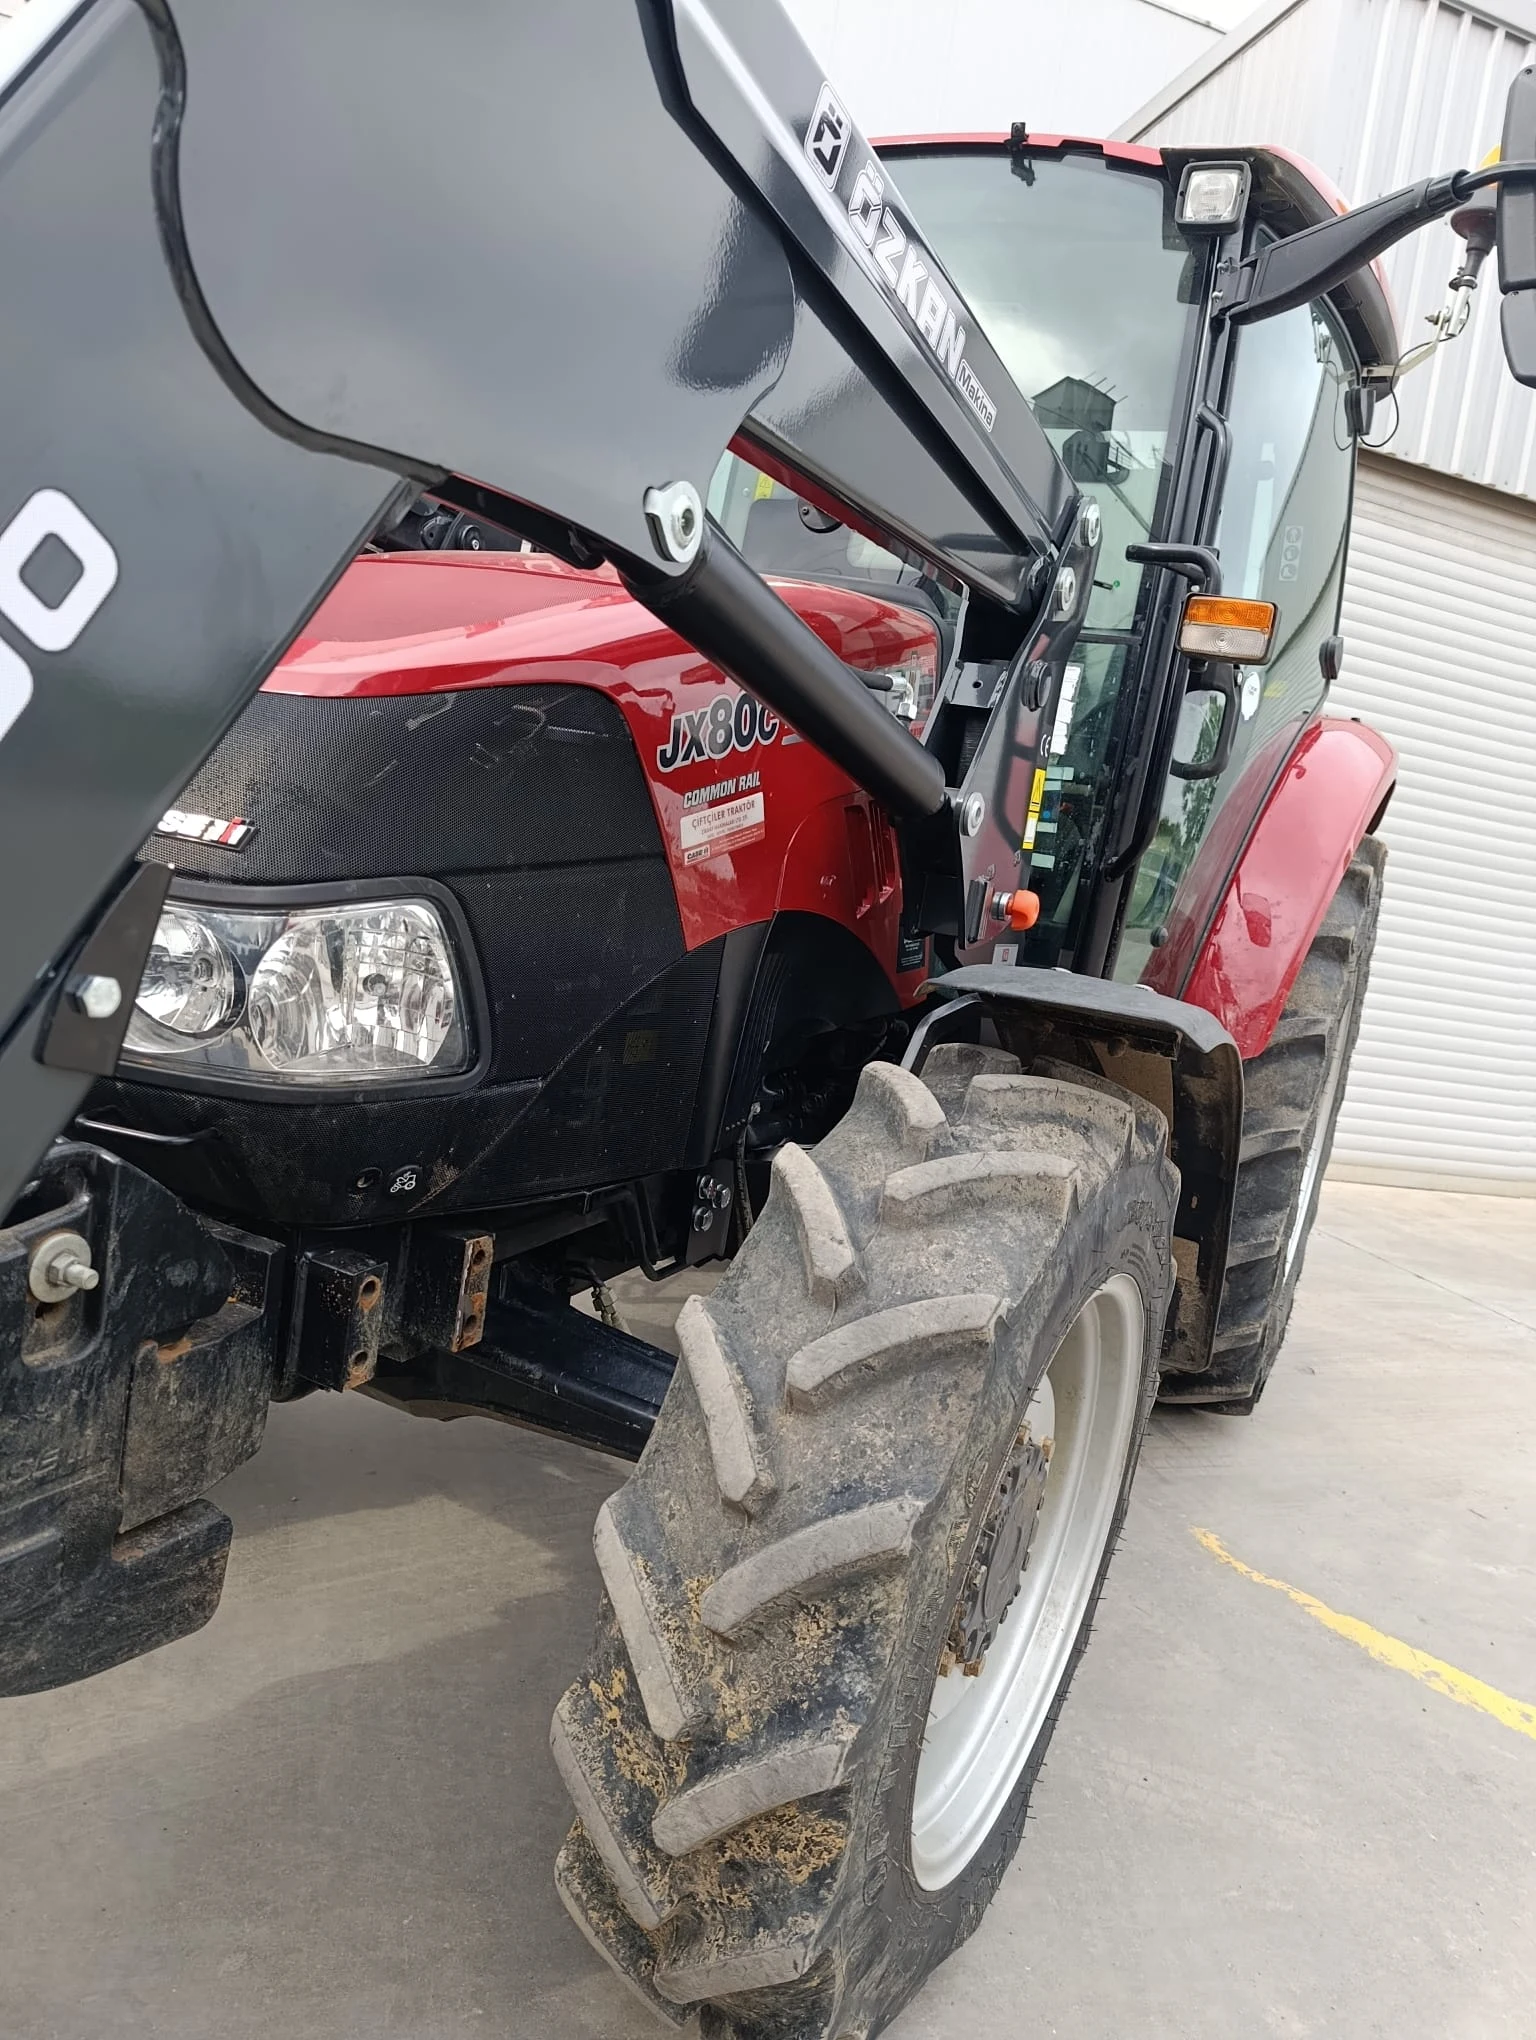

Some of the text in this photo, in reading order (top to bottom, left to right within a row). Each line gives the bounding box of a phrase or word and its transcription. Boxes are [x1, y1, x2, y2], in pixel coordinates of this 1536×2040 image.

[958, 364, 994, 428] Makina
[683, 771, 761, 809] COMMON RAIL
[726, 800, 756, 818] TRAKTÖR
